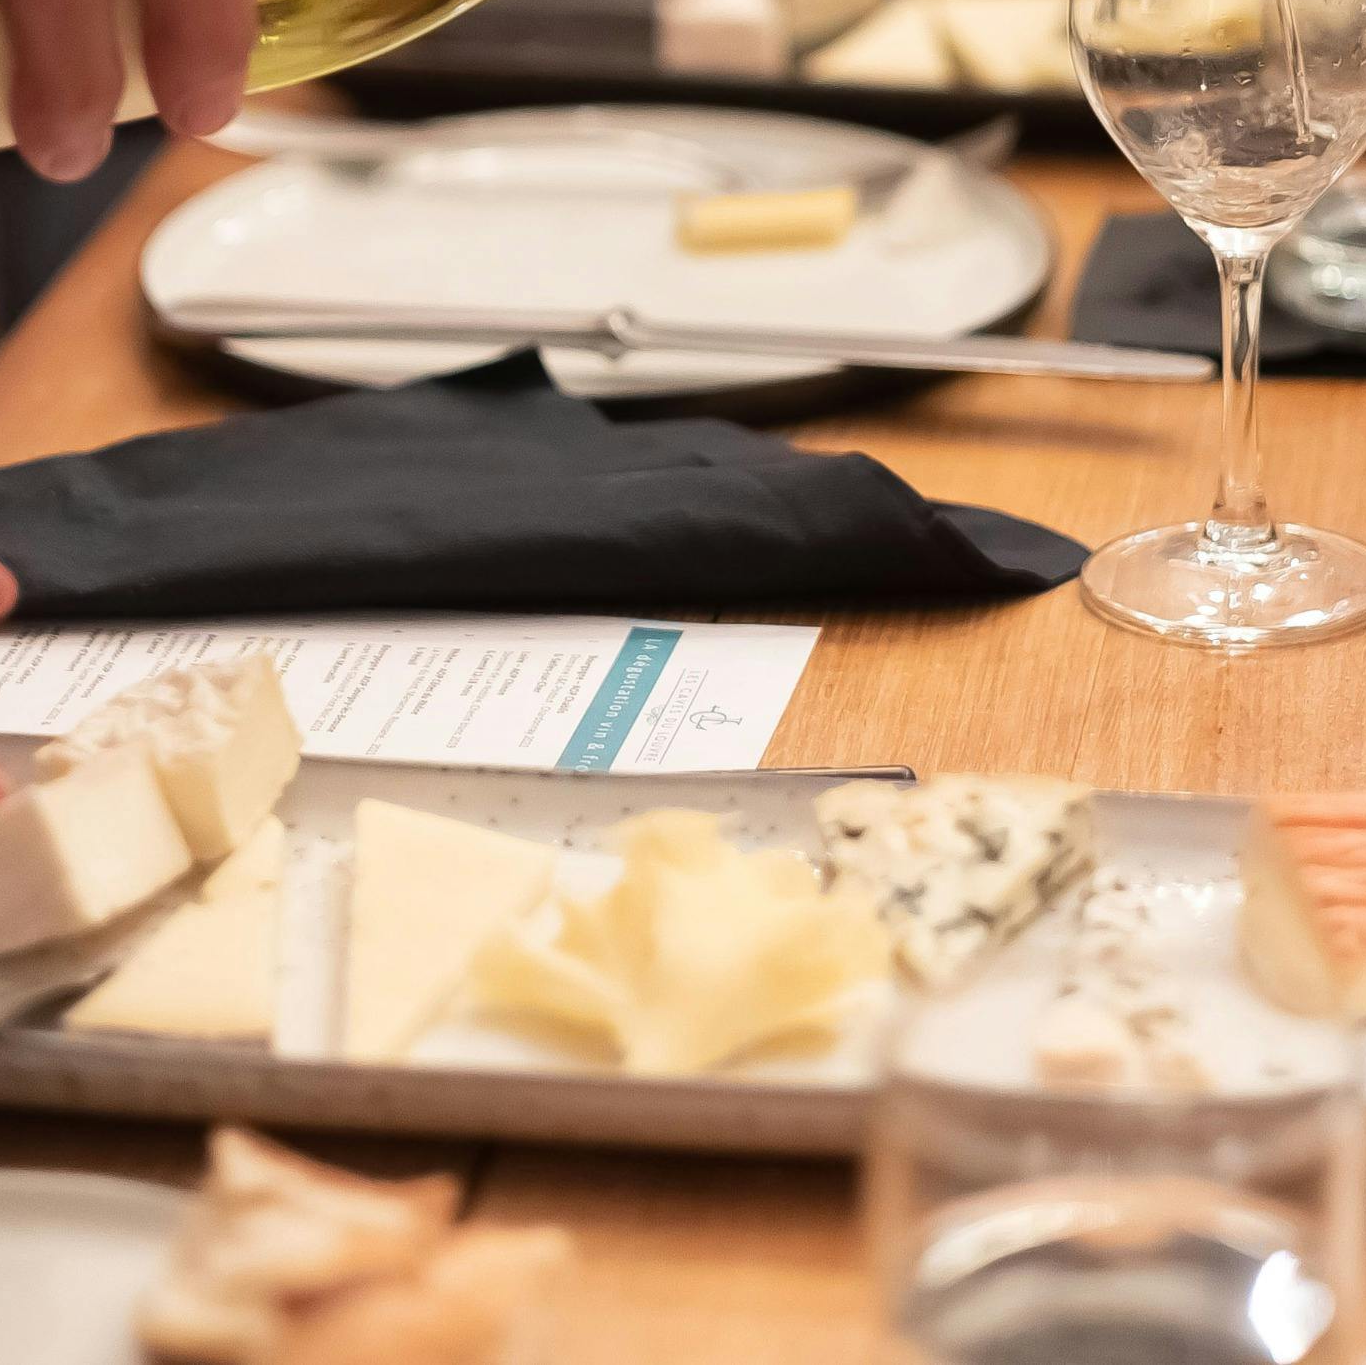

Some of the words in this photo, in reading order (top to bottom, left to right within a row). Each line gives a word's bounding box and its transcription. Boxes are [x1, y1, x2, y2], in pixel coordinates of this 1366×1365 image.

[643, 637, 662, 653] LA
[684, 670, 701, 684] LES
[605, 655, 652, 720] dégustation
[669, 687, 692, 714] CAVES
[593, 721, 614, 739] vin
[661, 717, 677, 729] DU
[586, 742, 605, 751] &
[643, 731, 667, 762] LOUVRE
